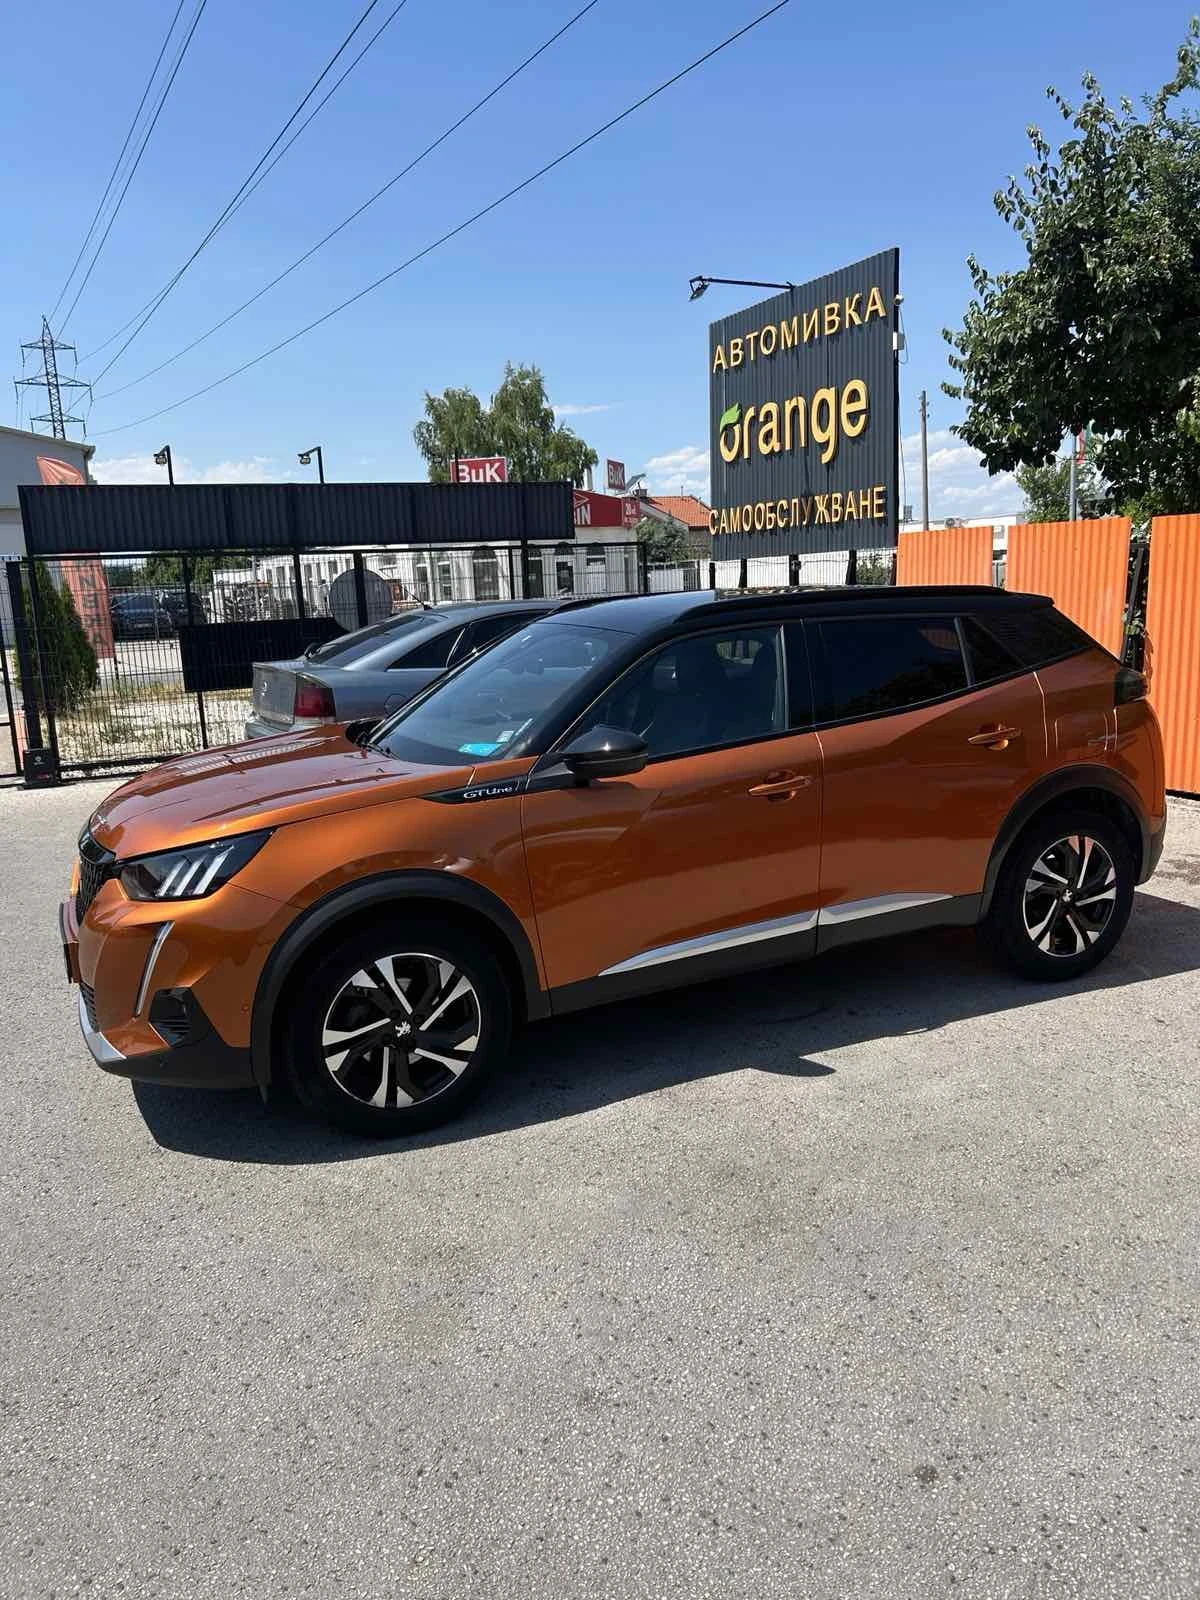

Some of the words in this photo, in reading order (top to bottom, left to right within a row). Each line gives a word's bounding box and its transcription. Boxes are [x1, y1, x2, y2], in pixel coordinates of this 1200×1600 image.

[713, 287, 887, 373] АВТОМИВКА
[719, 378, 869, 464] orange
[709, 486, 887, 535] САМООБСЛУЖВАНЕ
[463, 788, 486, 799] GT
[486, 786, 513, 795] Line
